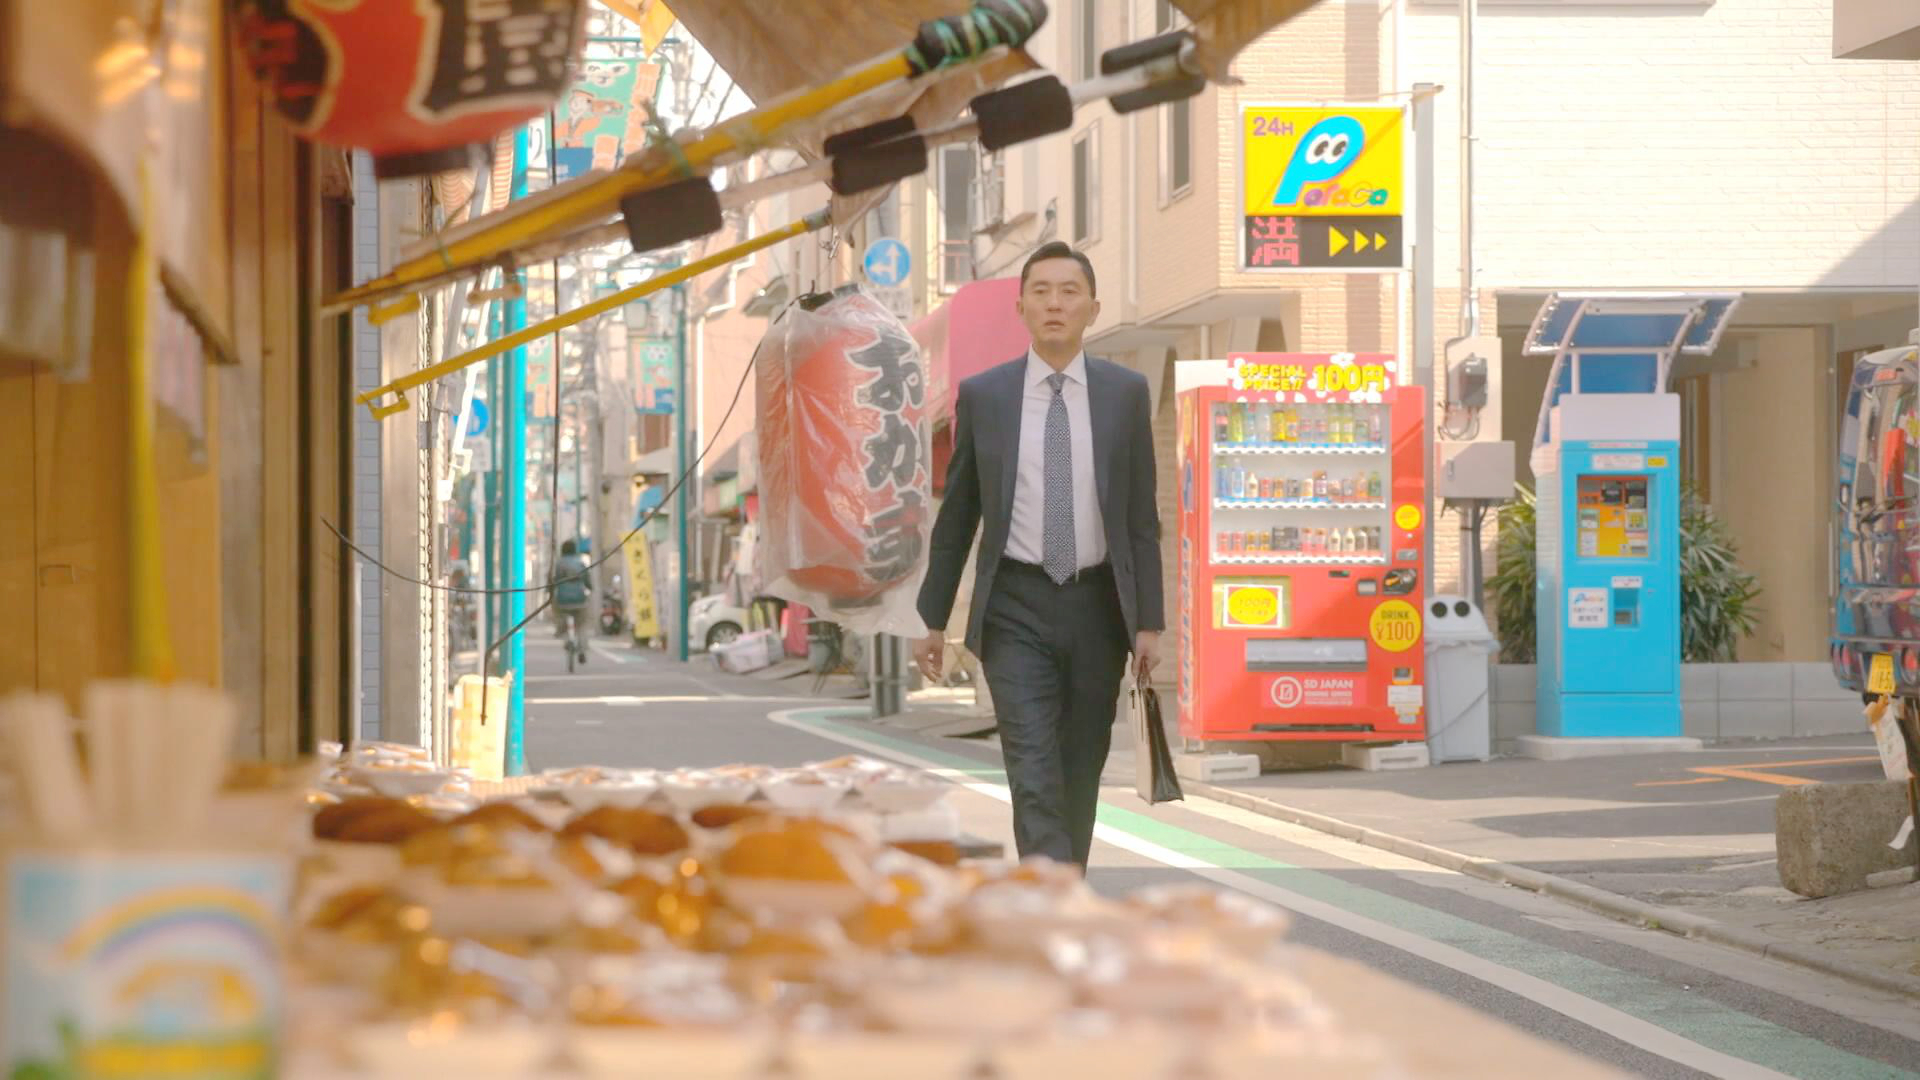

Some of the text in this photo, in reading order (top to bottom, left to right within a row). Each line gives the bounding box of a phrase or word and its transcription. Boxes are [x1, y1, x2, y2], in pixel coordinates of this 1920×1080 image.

[1253, 116, 1295, 137] 24H
[1251, 217, 1301, 267] 満
[1238, 363, 1307, 378] SPECIAL
[1312, 362, 1386, 393] 100円
[1381, 610, 1410, 620] DRINK
[1320, 679, 1354, 690] JAPAN
